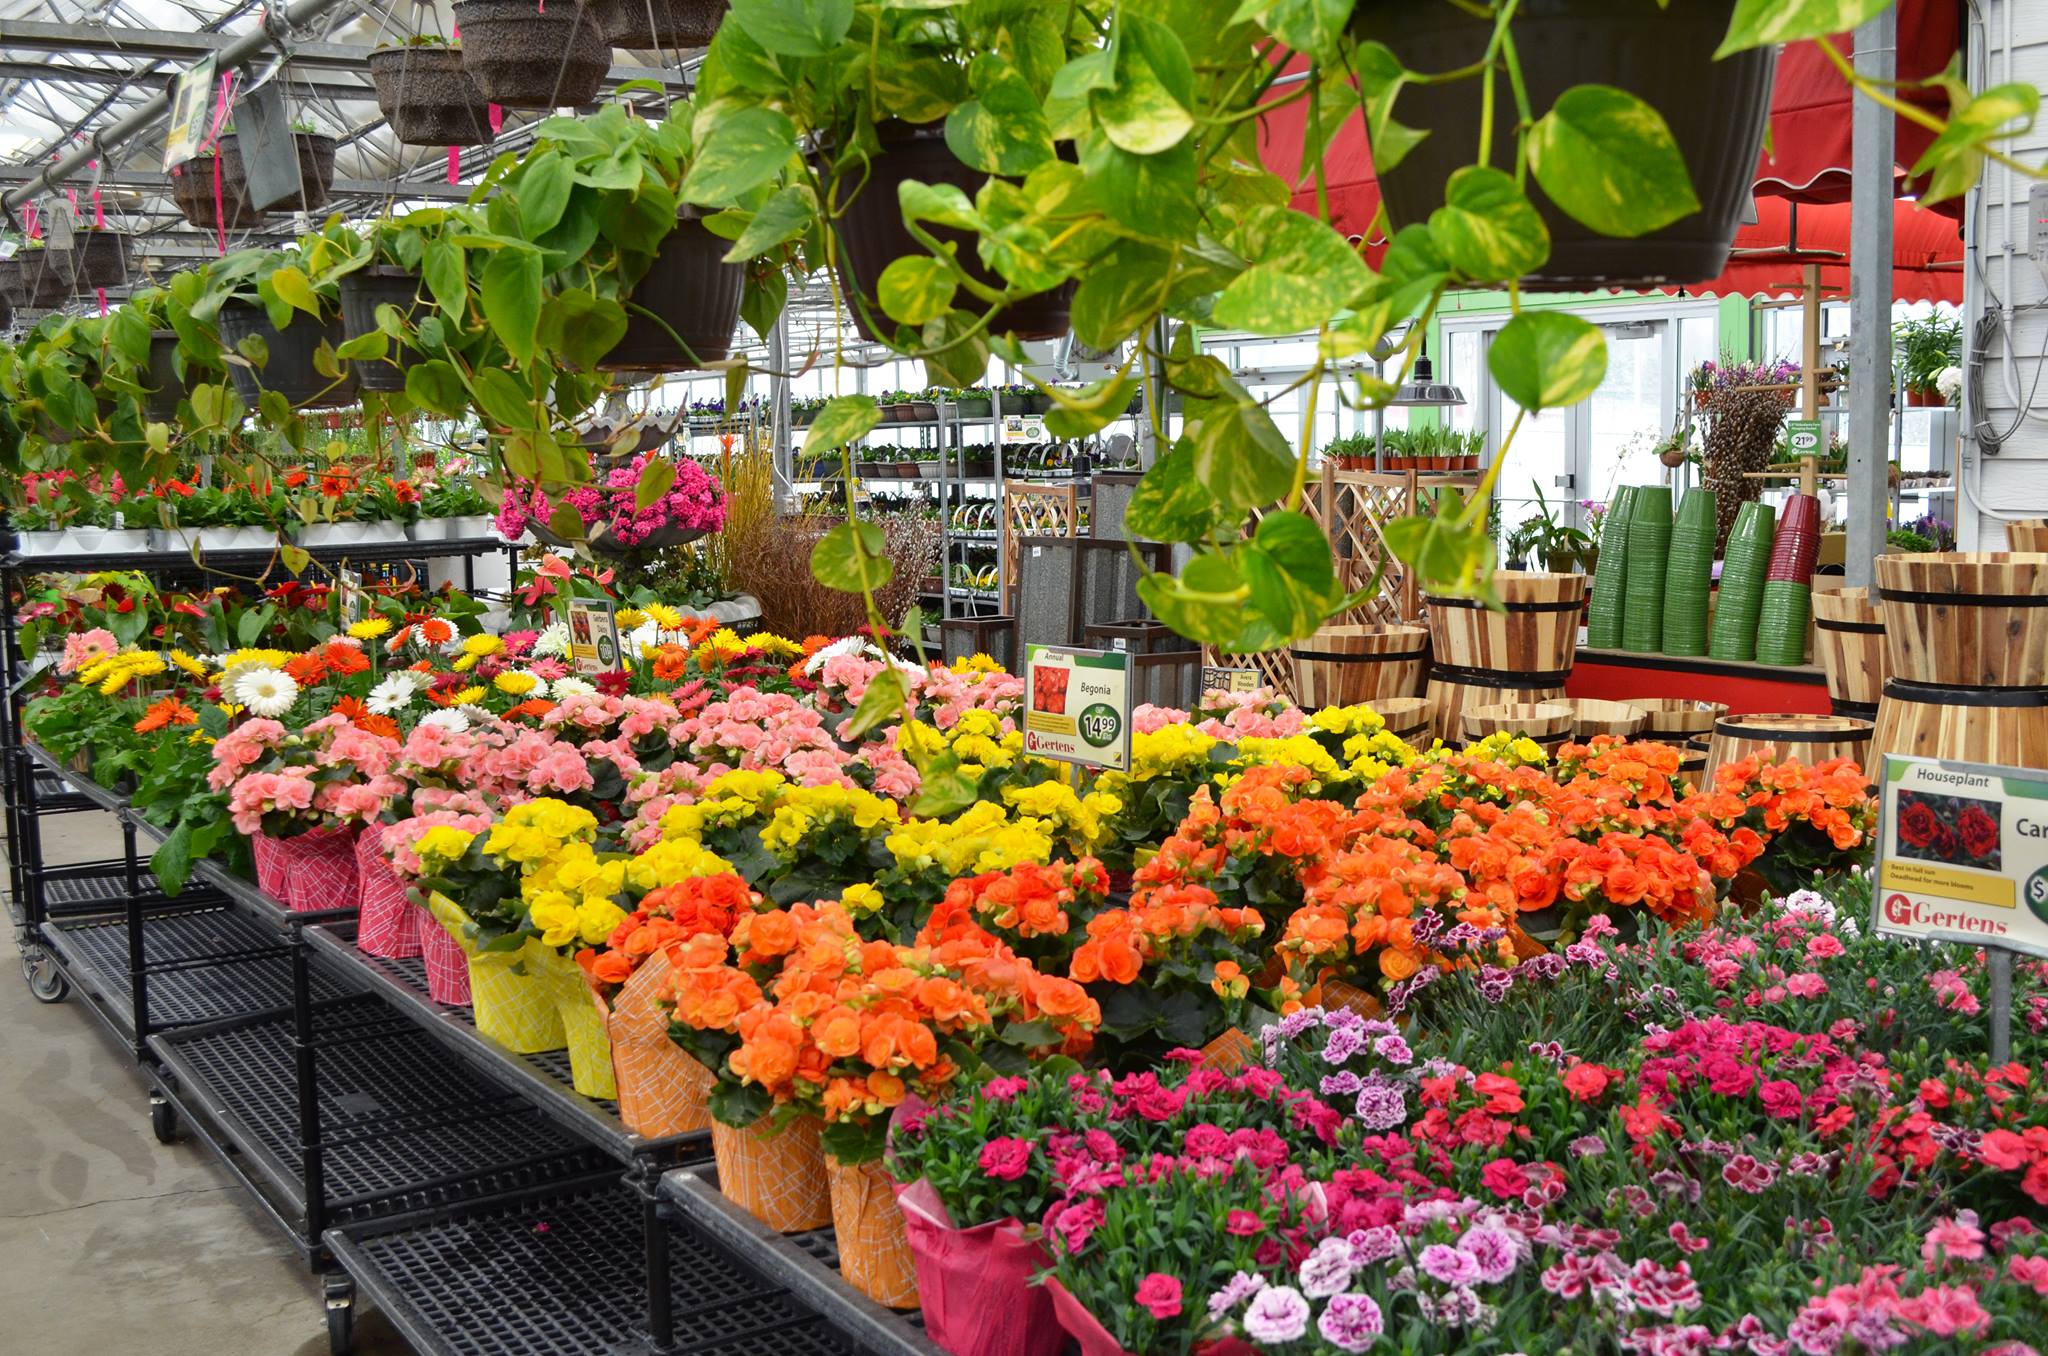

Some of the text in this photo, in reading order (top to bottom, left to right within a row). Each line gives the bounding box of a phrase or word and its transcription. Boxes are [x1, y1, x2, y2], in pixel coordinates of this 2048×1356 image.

[1044, 652, 1065, 661] Annual
[1080, 682, 1111, 696] Begonia
[1037, 735, 1076, 753] Gertens
[1916, 768, 1989, 788] Houseplant
[1891, 863, 1904, 871] Best
[1890, 872, 1922, 882] Deadhead
[1933, 879, 1950, 887] more
[1951, 880, 1974, 891] blooms
[1912, 901, 2009, 935] Gertens
